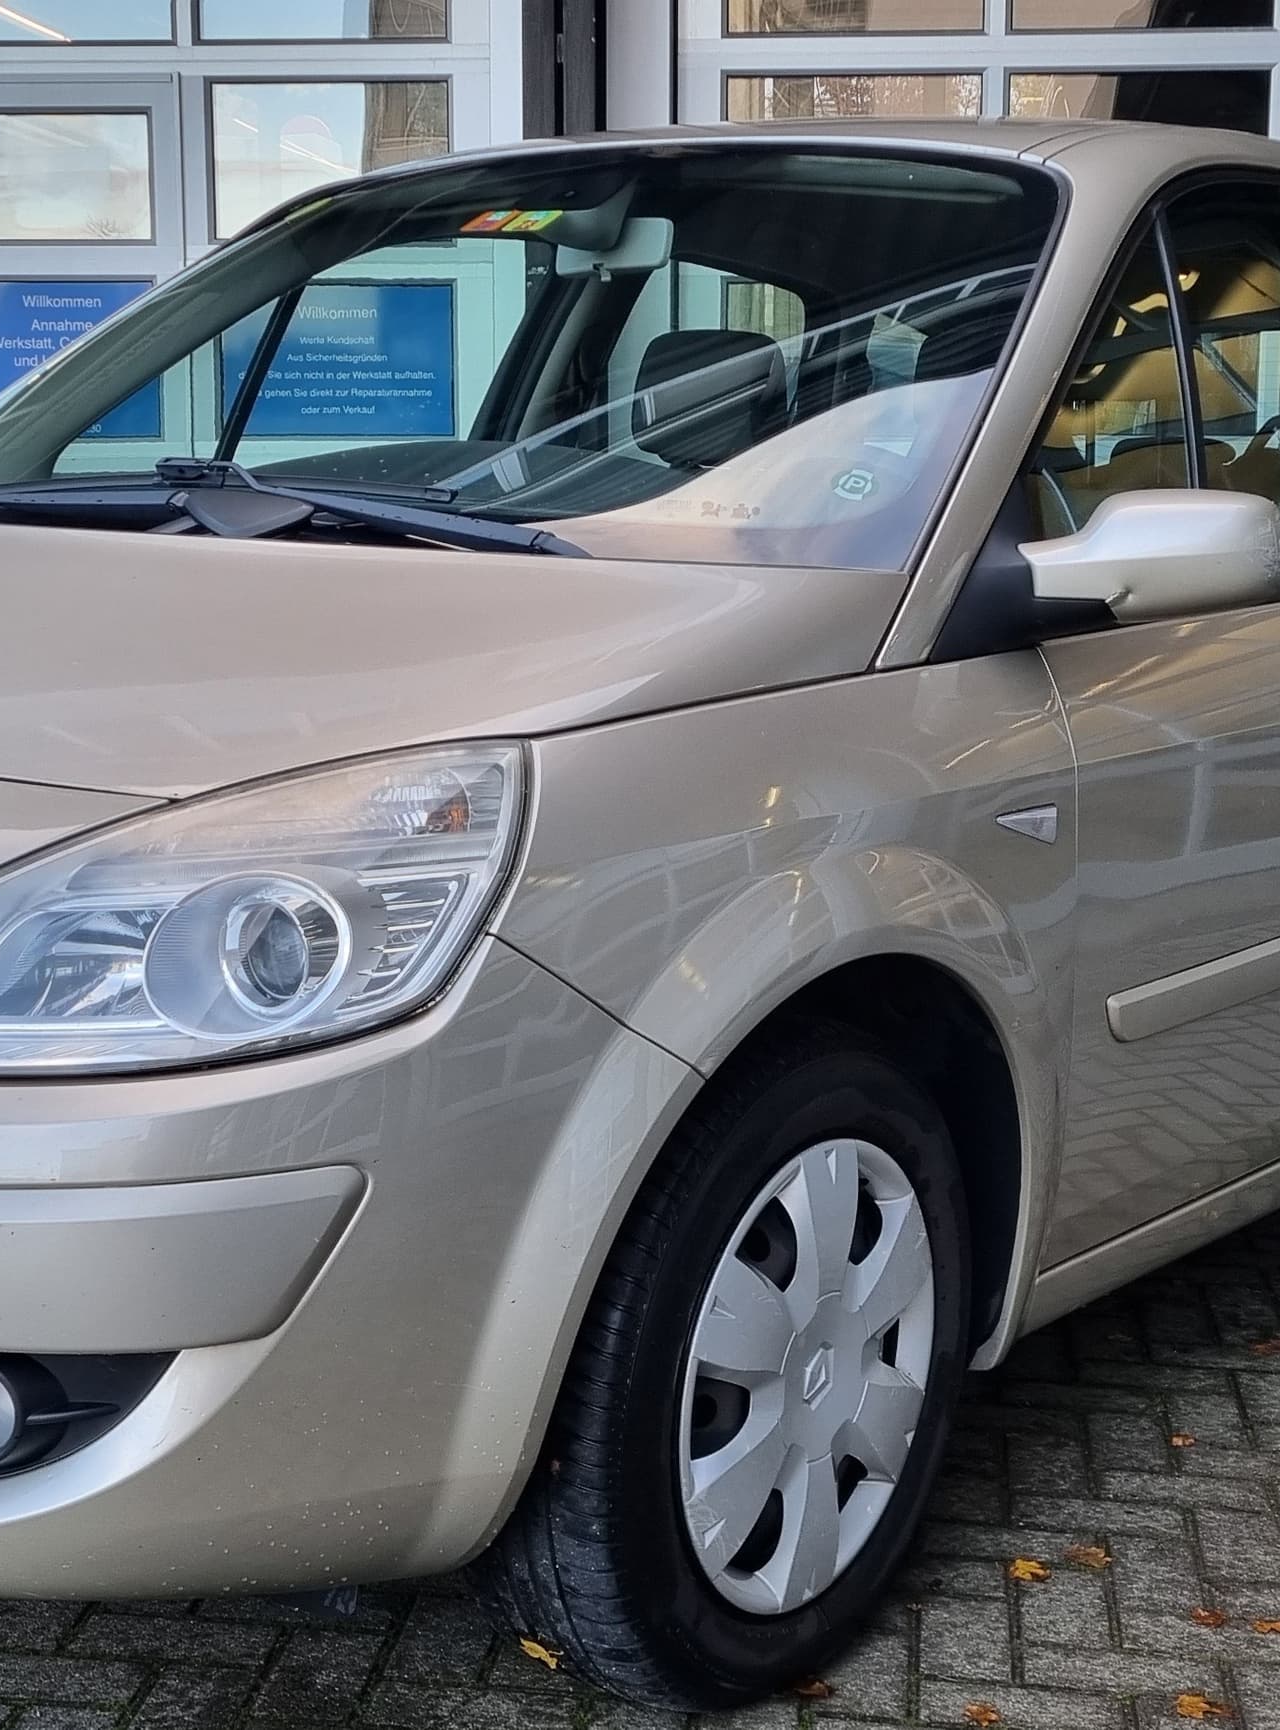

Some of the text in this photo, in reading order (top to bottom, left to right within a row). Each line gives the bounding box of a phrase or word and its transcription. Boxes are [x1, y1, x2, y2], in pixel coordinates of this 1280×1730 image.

[22, 295, 102, 309] Willkommen
[297, 306, 377, 320] Willkommen
[31, 319, 93, 332] Annahme
[327, 335, 375, 345] Kundschaft
[14, 355, 38, 367] und
[287, 353, 388, 364] Aus Sicherheitsgründen
[284, 370, 301, 380] sich
[304, 371, 324, 380] nicht
[336, 371, 351, 380] der
[352, 371, 393, 380] Werkstatt
[265, 388, 292, 399] gehen
[294, 388, 308, 397] Sie
[310, 388, 333, 397] direkt
[301, 405, 376, 415] oder zum Verkauf
